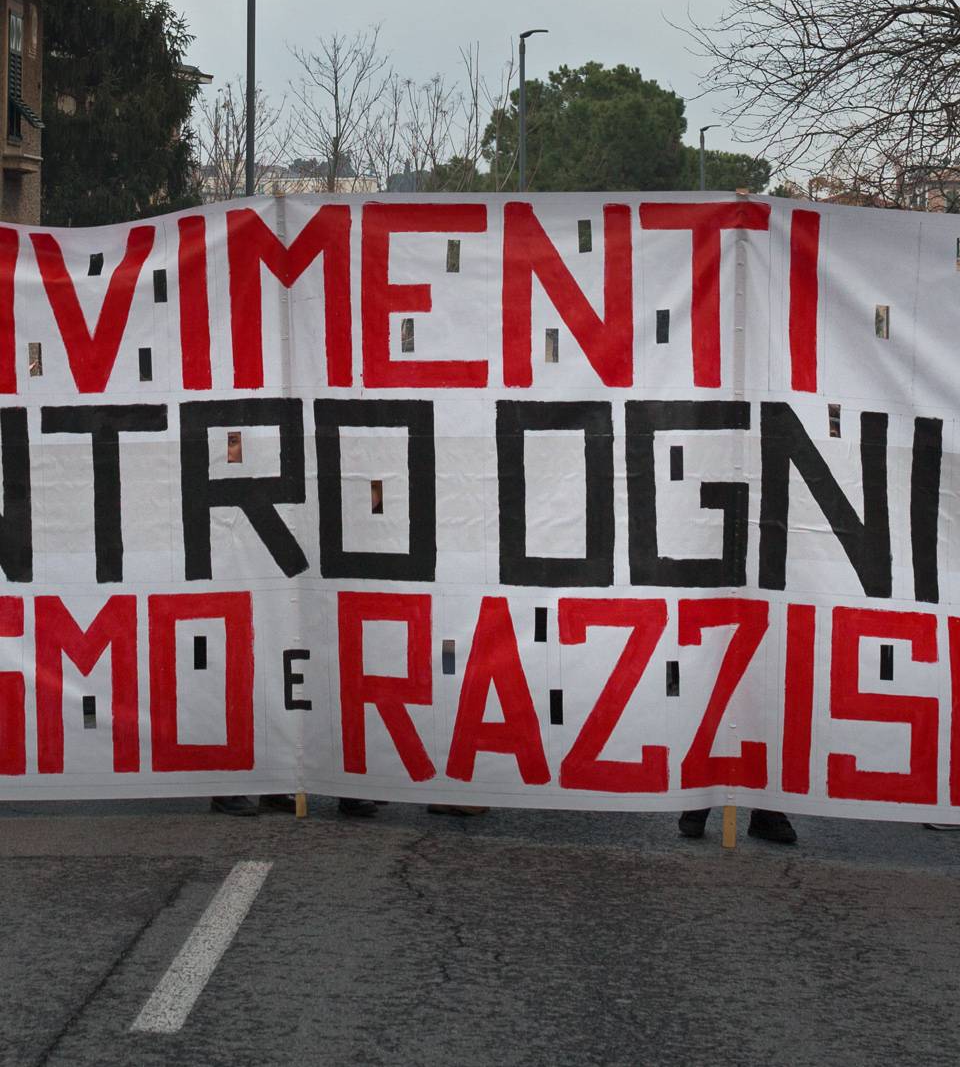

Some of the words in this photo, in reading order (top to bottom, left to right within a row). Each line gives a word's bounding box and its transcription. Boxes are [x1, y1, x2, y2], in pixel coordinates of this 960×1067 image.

[0, 201, 820, 394] VIMENTI
[0, 398, 437, 584] TRO
[496, 400, 943, 604] OGNI
[0, 590, 255, 776] MO
[283, 649, 312, 711] E
